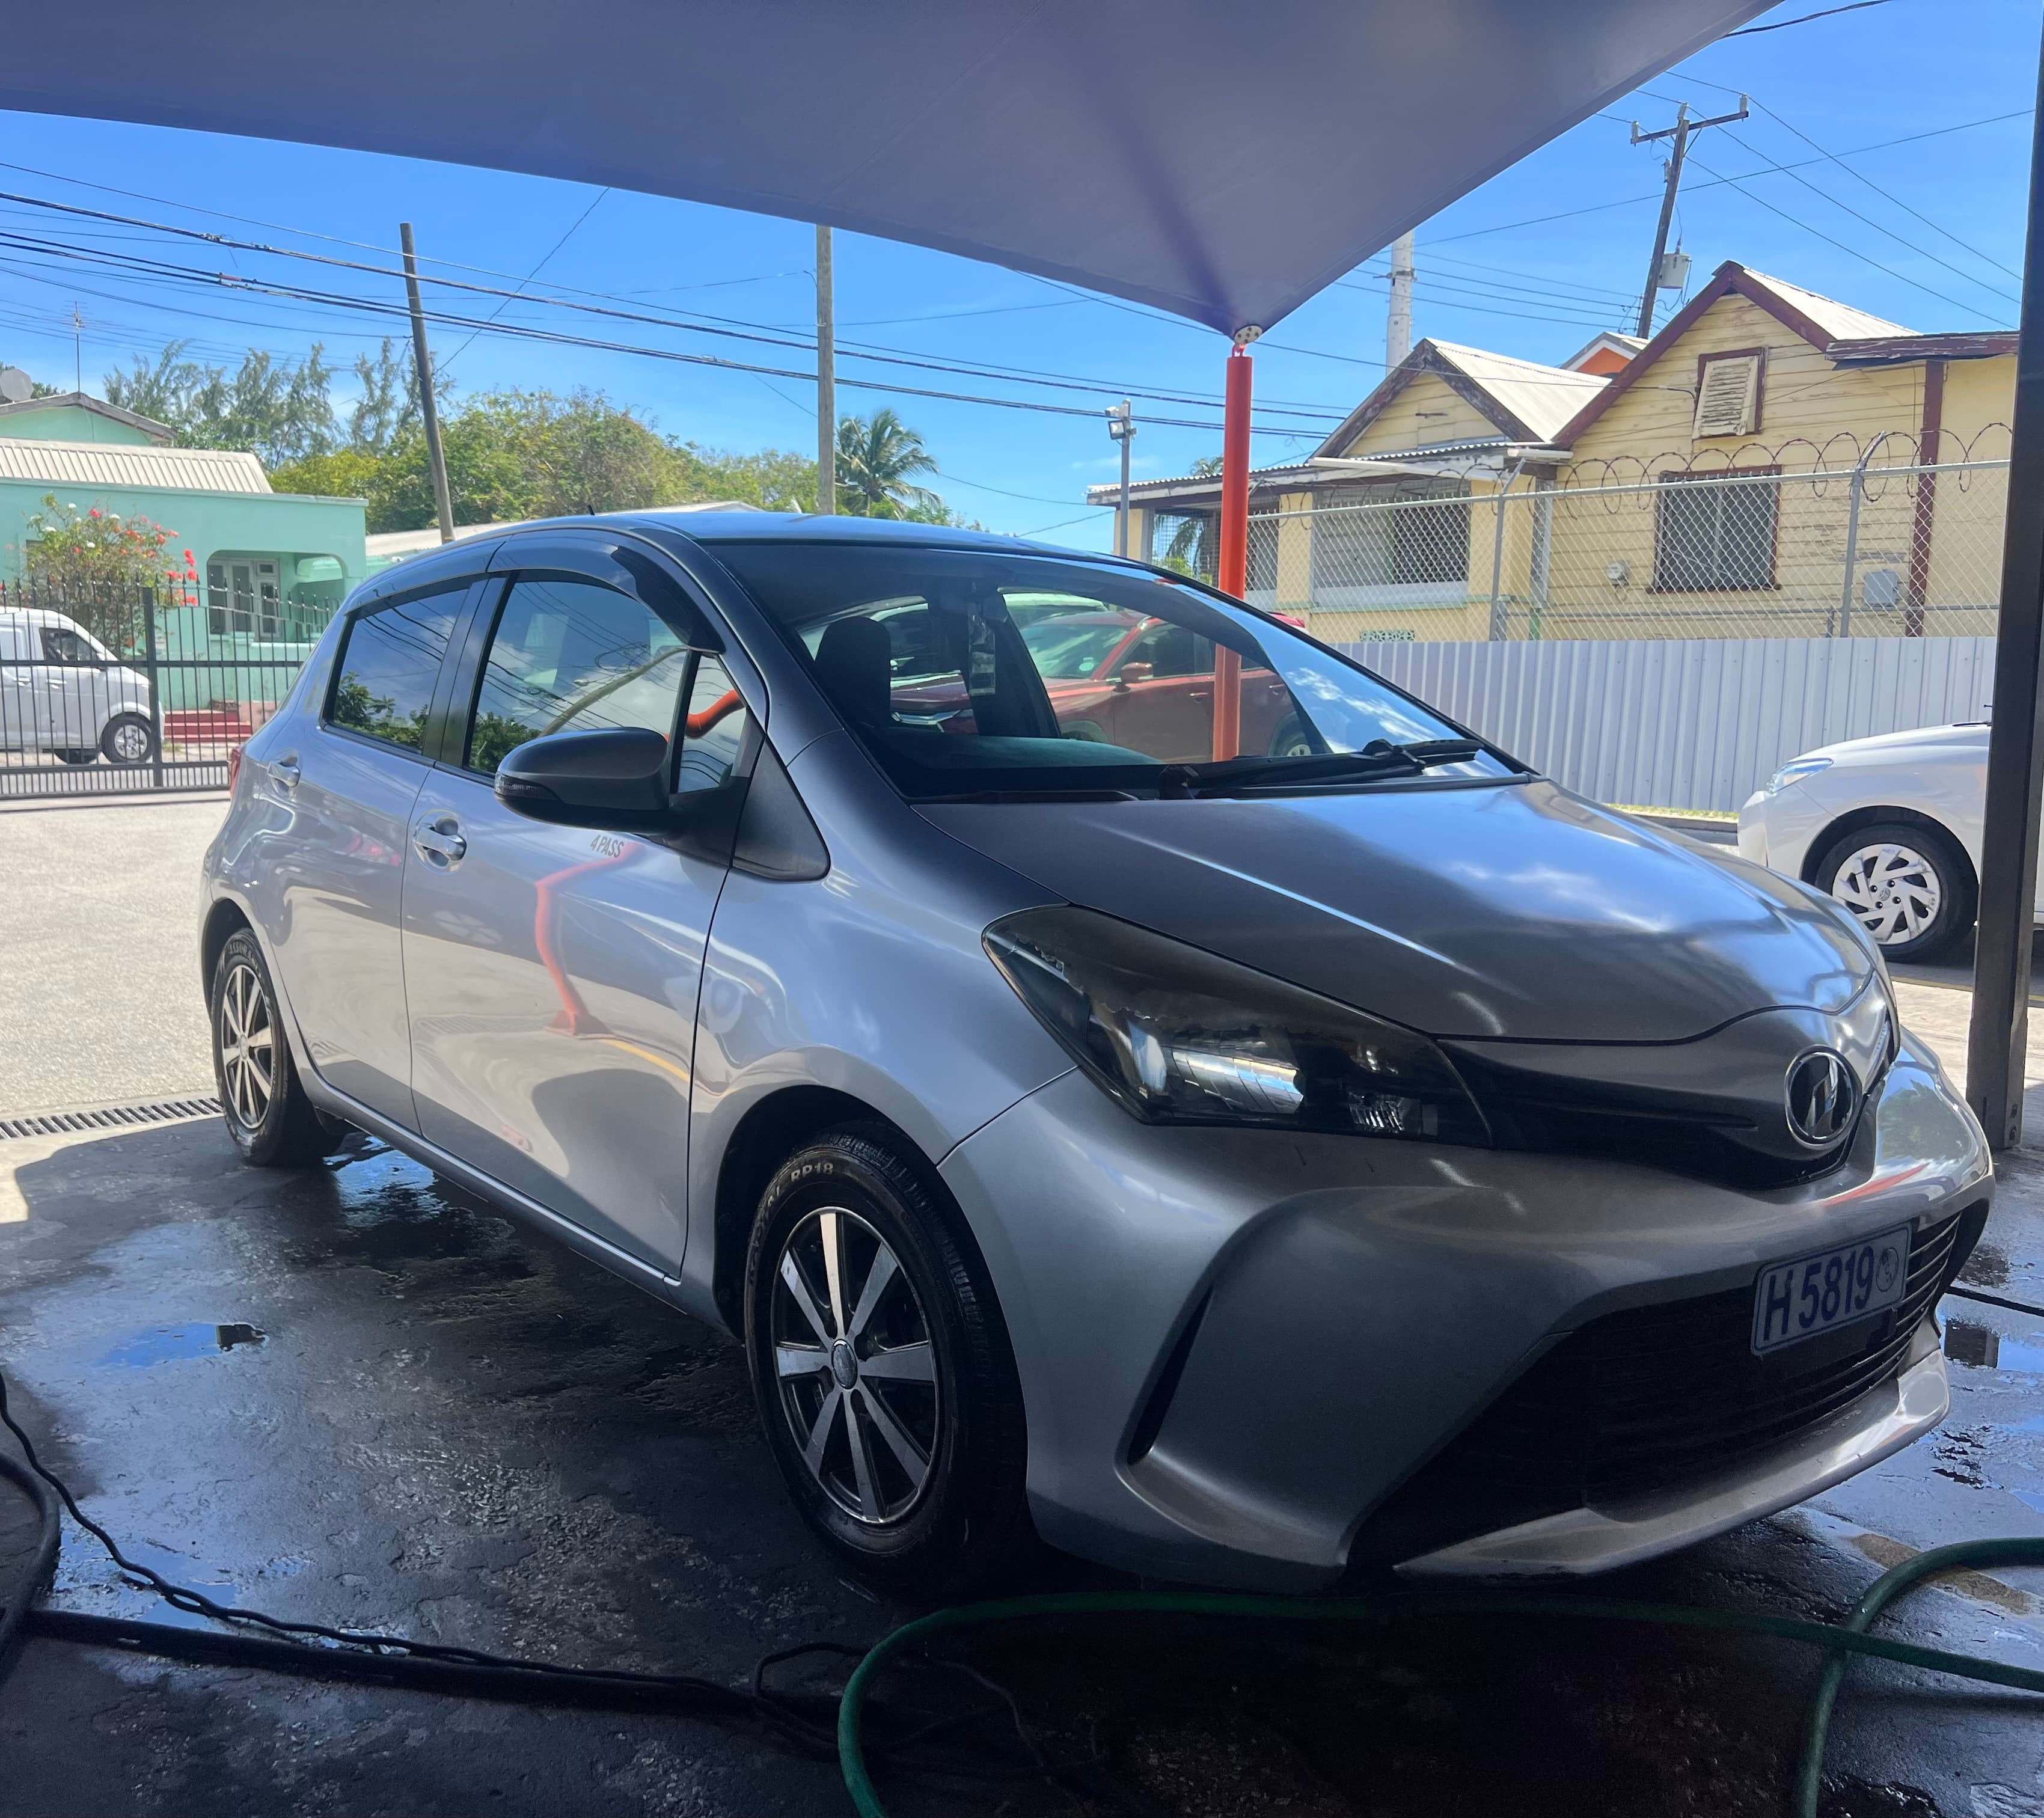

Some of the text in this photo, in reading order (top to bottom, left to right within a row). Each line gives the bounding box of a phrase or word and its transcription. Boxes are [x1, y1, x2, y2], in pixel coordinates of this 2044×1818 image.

[590, 834, 624, 858] 4 PASS
[791, 1162, 834, 1182] RP18
[1763, 1245, 1874, 1341] H 5819
